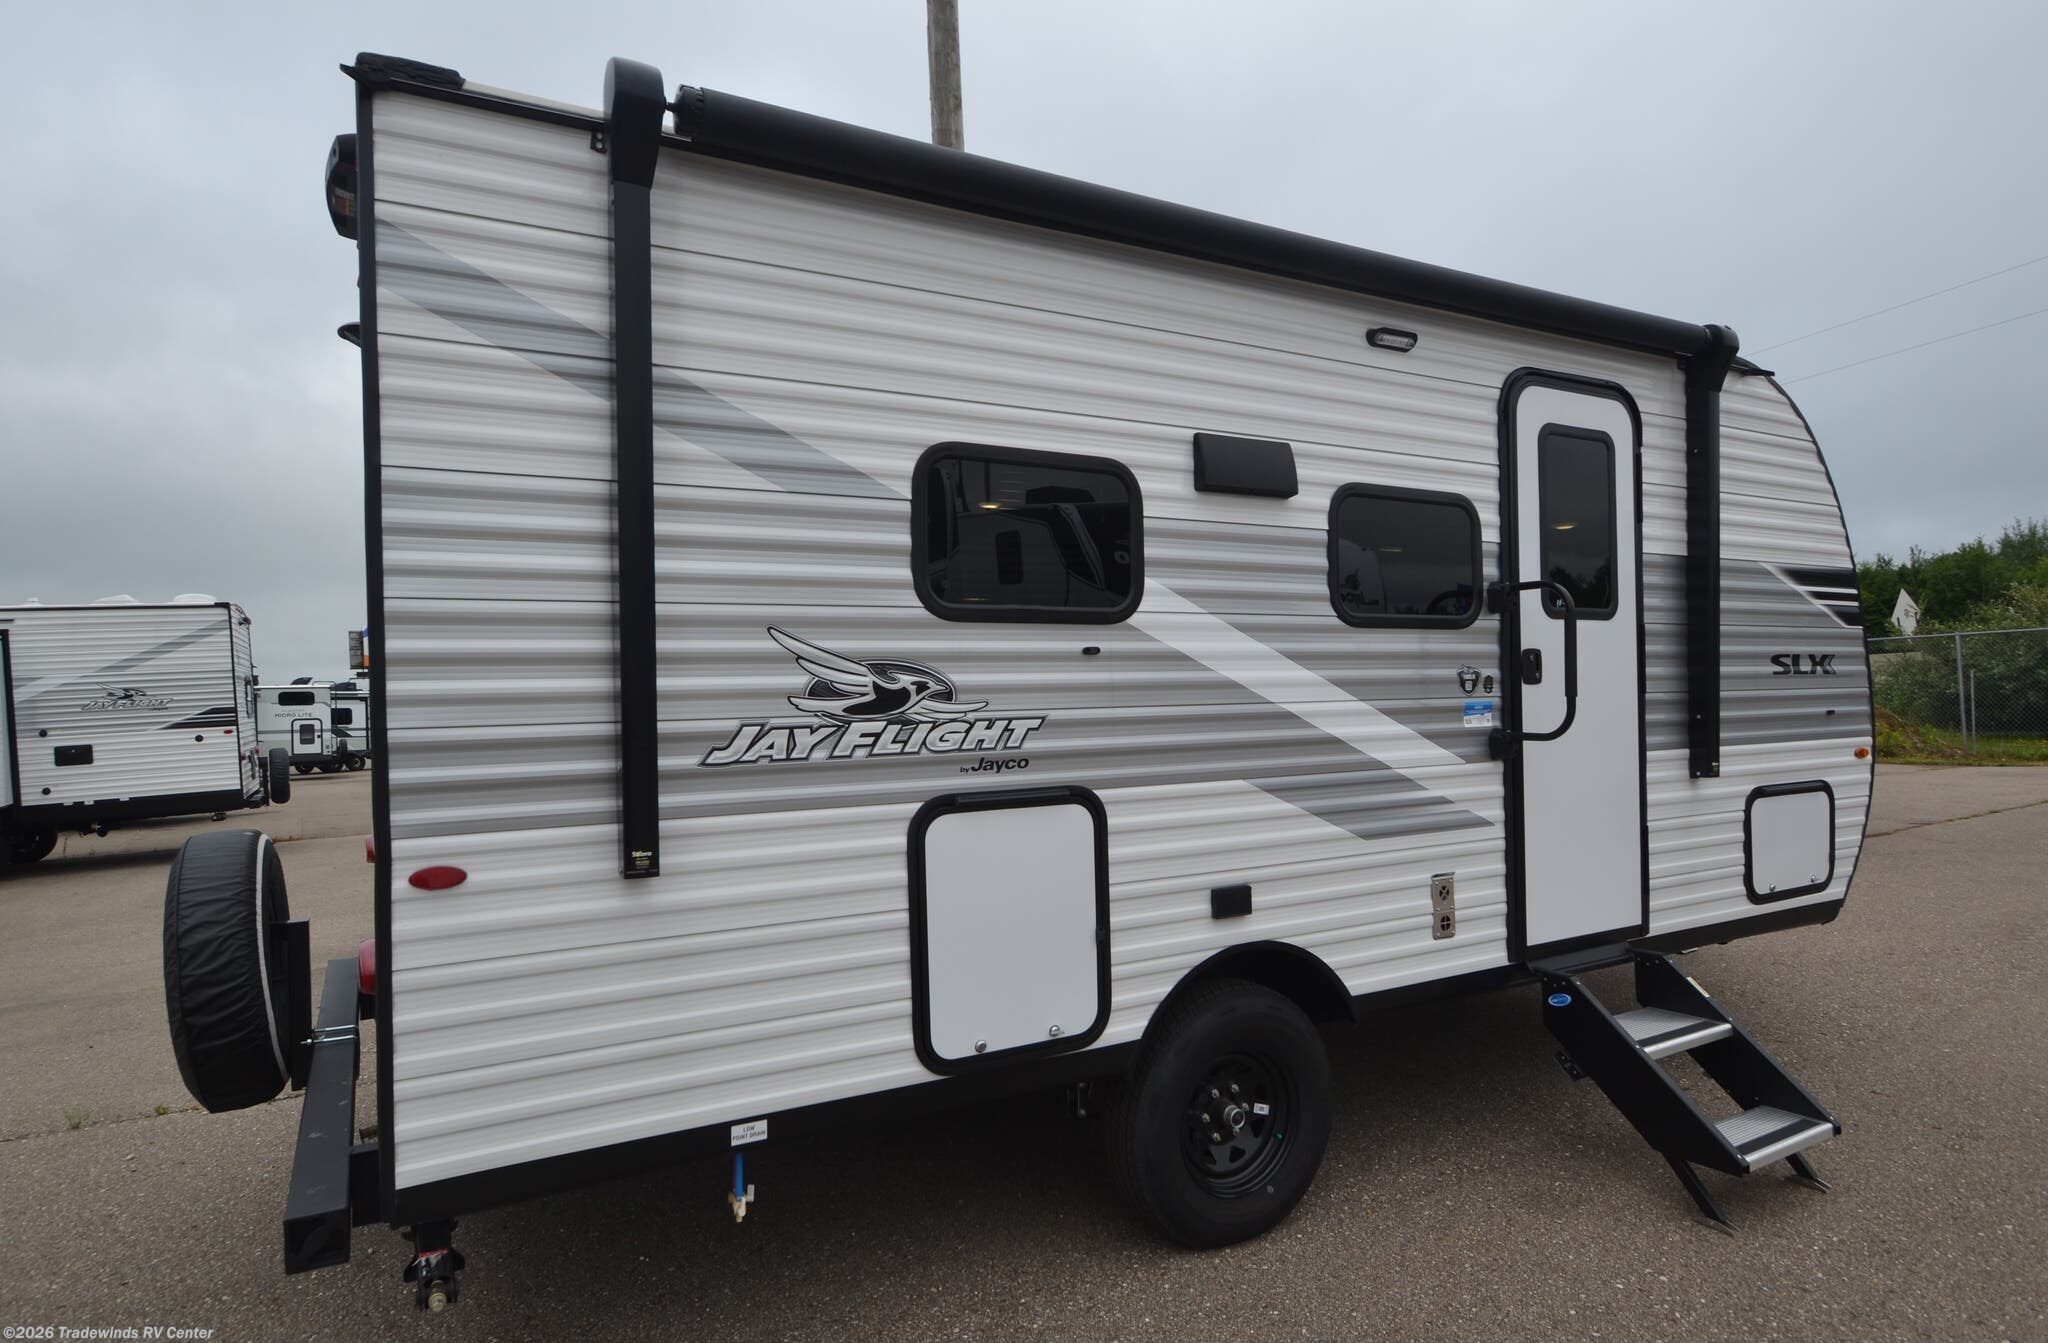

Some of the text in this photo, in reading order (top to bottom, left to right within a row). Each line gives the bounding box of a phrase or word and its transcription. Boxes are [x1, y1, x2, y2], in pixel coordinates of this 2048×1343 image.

[1770, 653, 1836, 675] SLX
[696, 714, 1048, 768] JAY FLIGHT
[960, 757, 1029, 774] by Jayco
